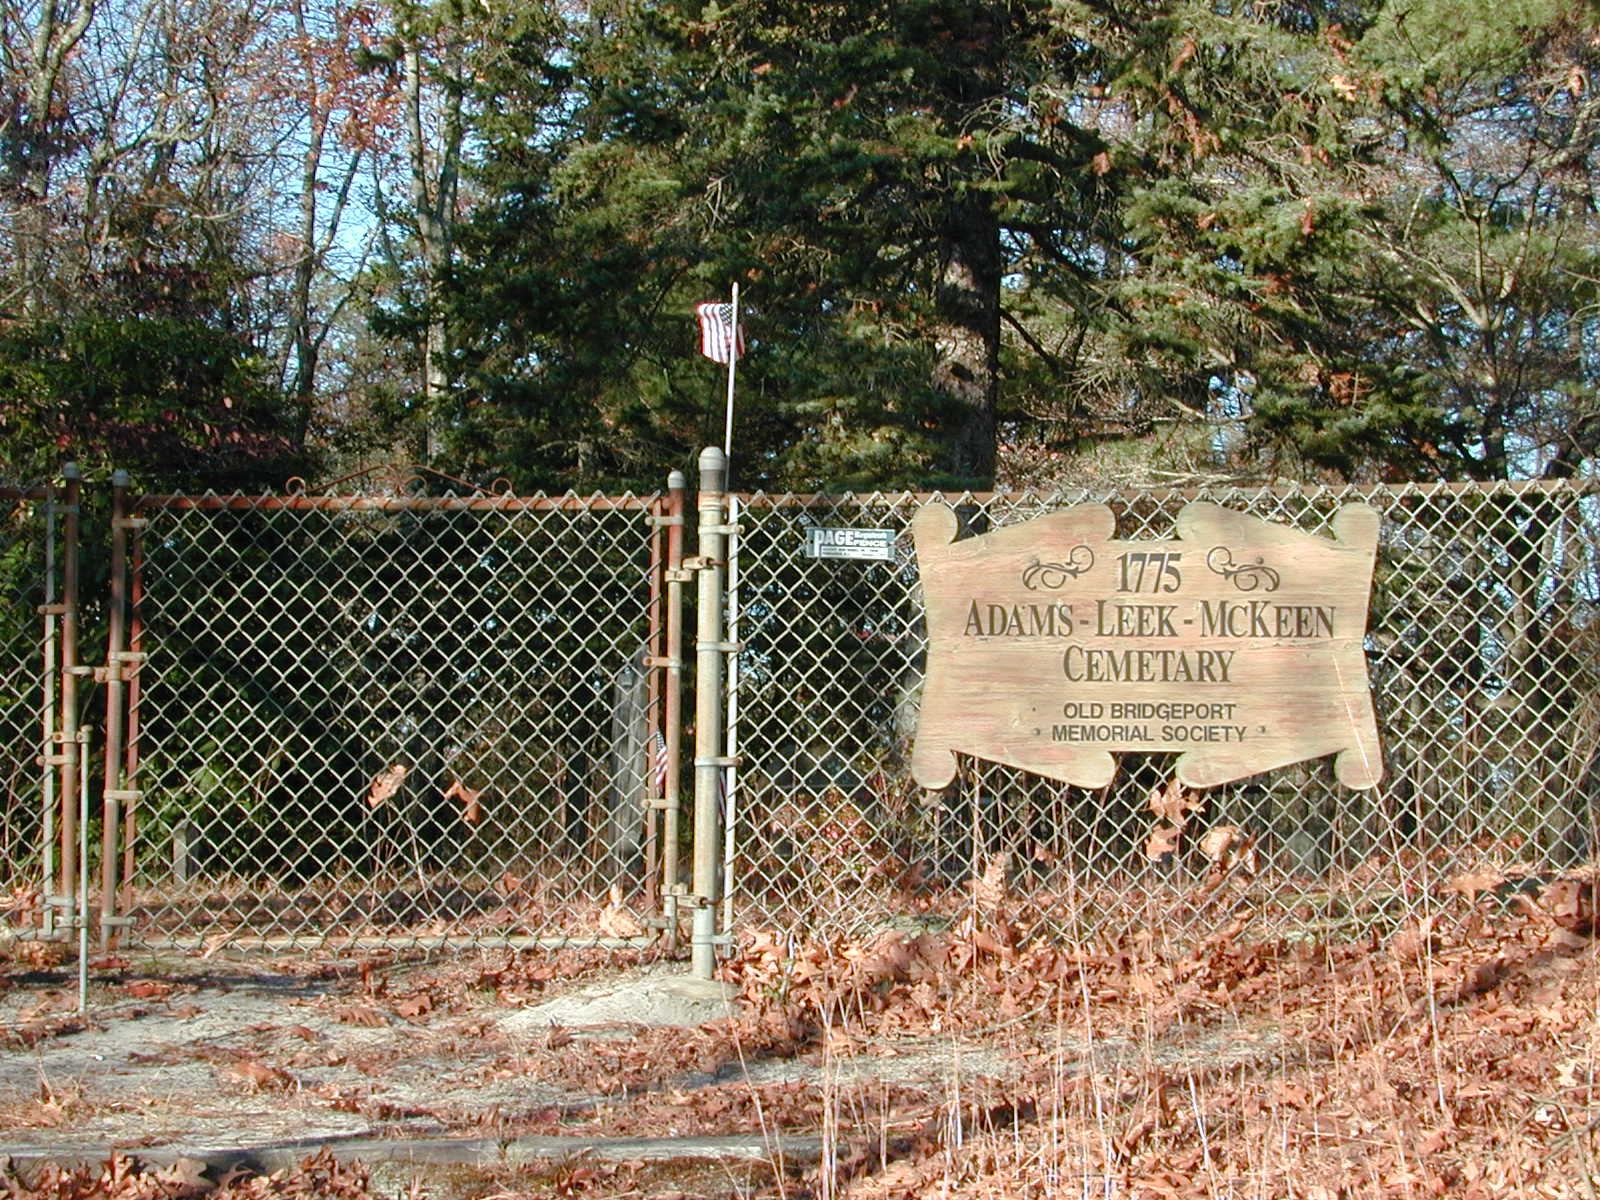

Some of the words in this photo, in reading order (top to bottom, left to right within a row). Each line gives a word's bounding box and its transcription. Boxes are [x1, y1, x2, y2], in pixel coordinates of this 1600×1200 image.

[814, 530, 854, 553] PAGE
[1117, 552, 1182, 593] 1775
[1063, 645, 1235, 683] CEMETARY
[1064, 703, 1103, 720] OLD
[1111, 704, 1236, 720] BRIDGEPORT
[1052, 725, 1154, 742] MEMORIAL
[1161, 725, 1247, 742] SOCIETY
